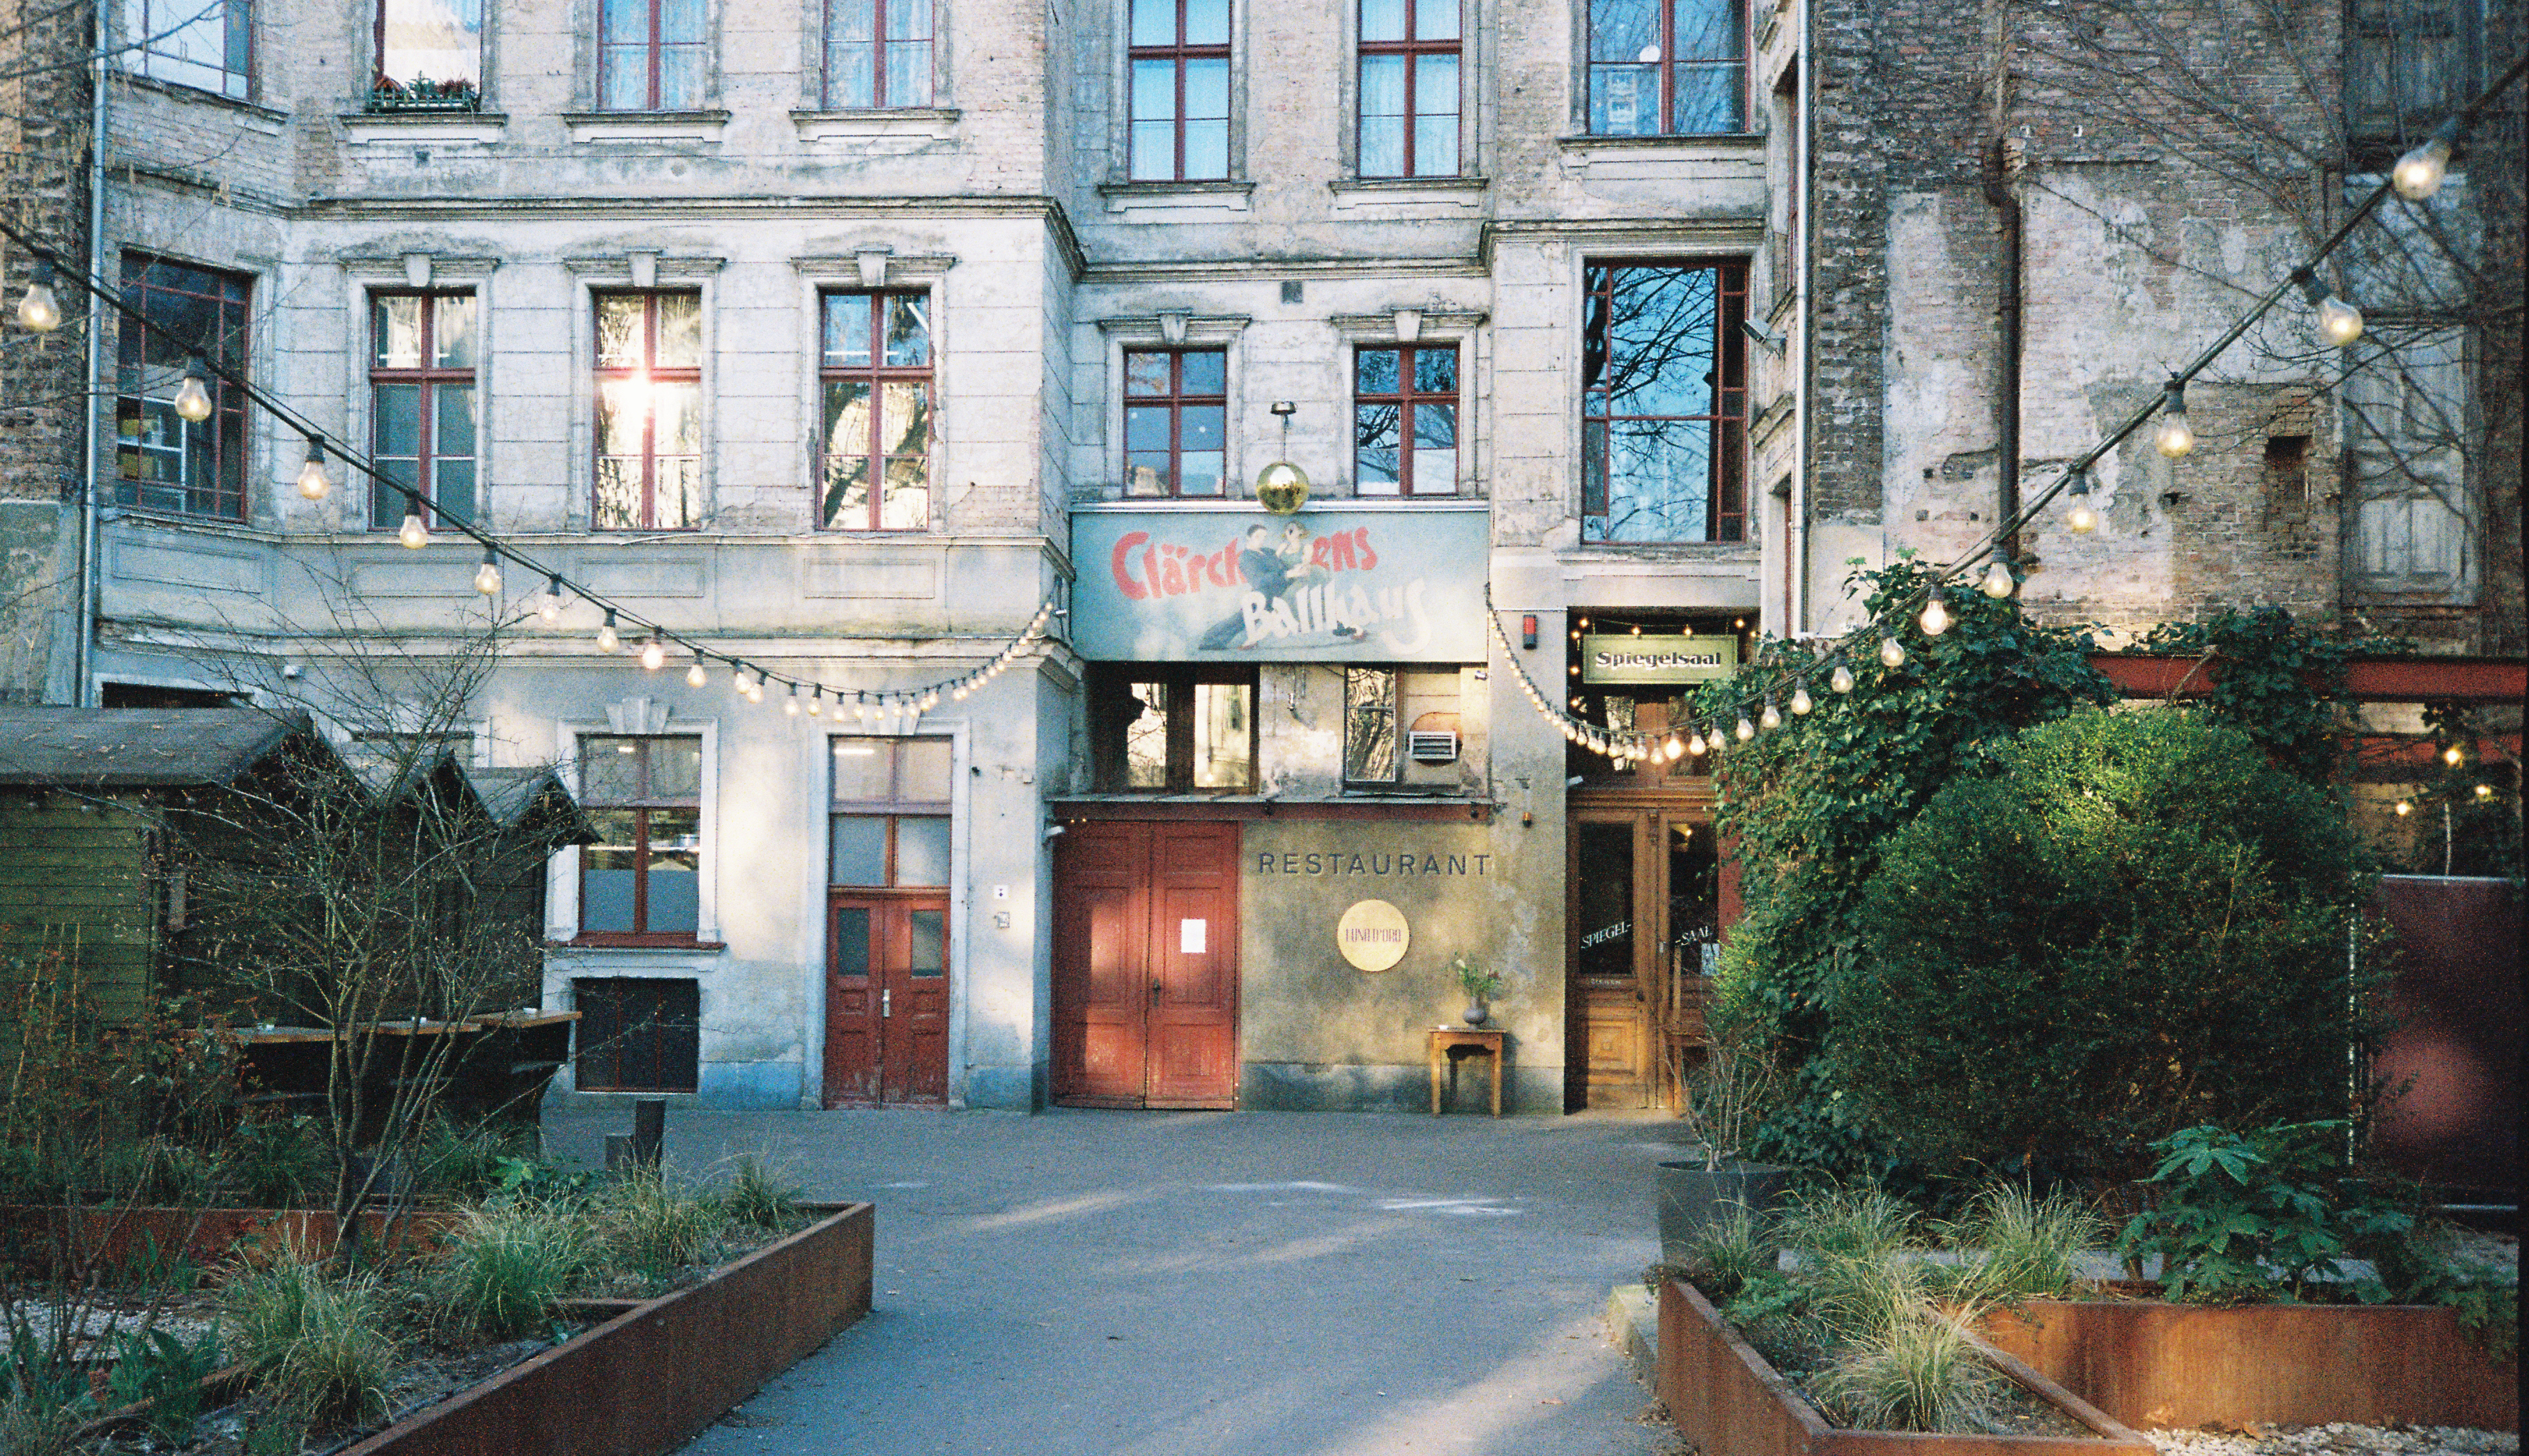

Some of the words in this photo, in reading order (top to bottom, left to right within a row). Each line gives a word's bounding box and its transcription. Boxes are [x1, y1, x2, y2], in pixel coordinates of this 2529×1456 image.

[1111, 526, 1378, 601] Clärchens
[1241, 577, 1431, 656] Ballhaus
[1595, 651, 1721, 671] Spiegelsaal
[1259, 853, 1492, 876] RESTAURANT
[1346, 928, 1370, 943] LUNA
